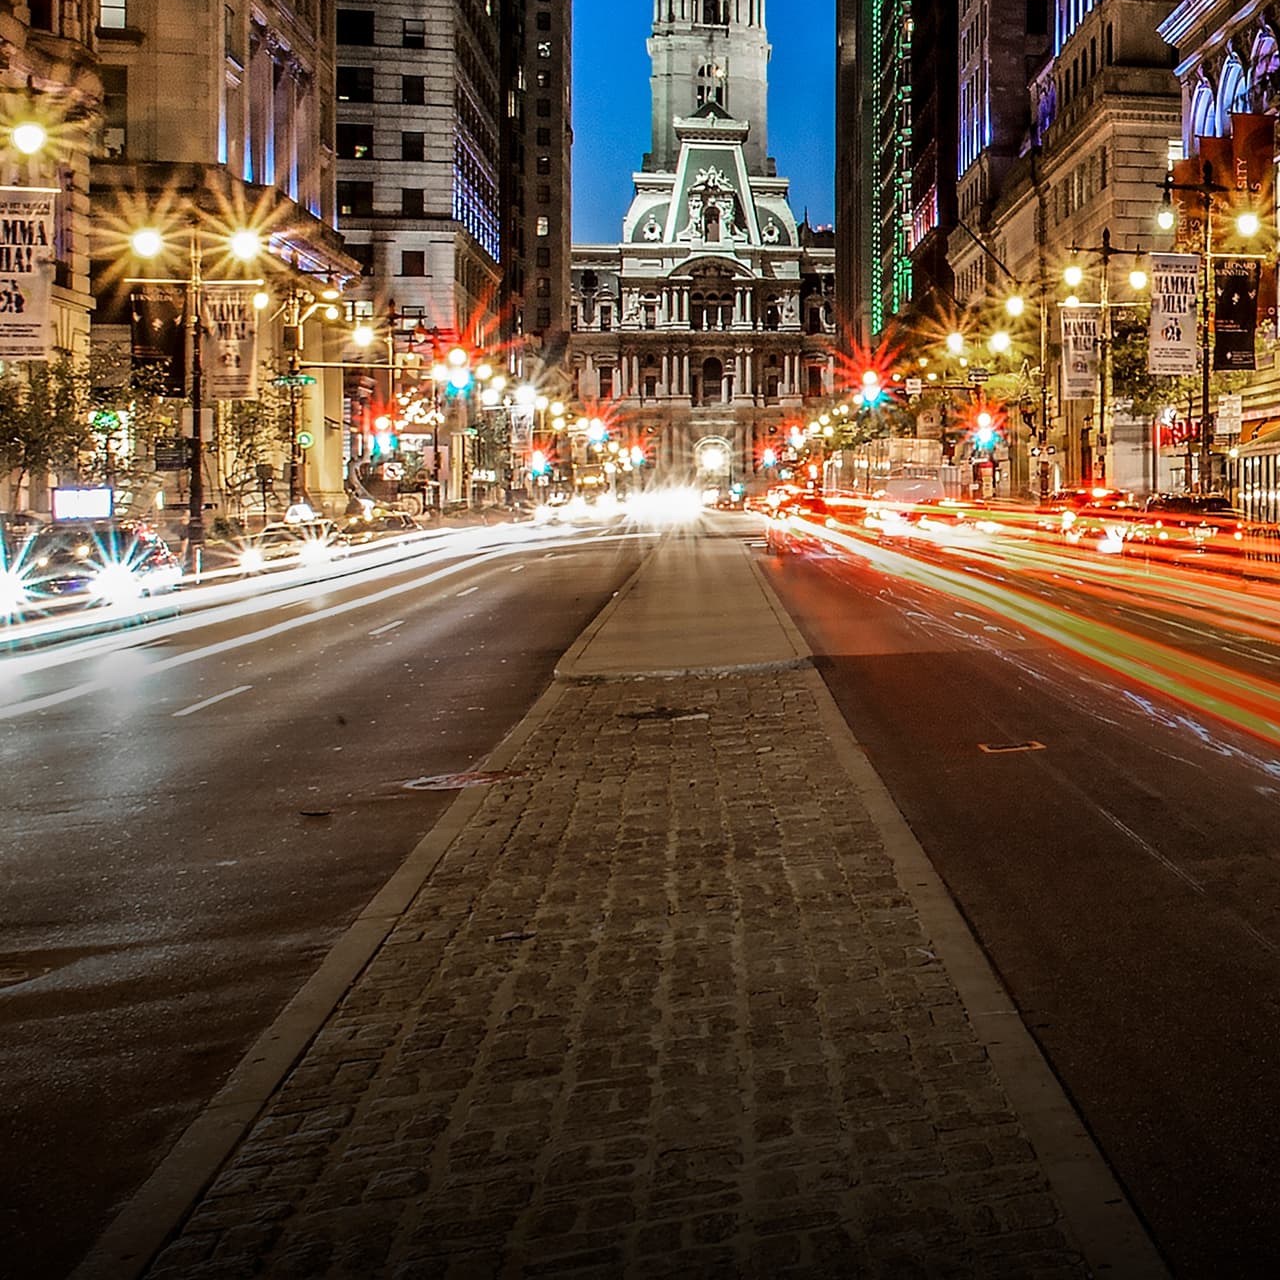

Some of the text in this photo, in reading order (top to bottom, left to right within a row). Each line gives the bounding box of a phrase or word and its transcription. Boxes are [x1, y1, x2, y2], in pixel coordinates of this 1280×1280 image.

[0, 219, 48, 246] MMA
[1153, 275, 1197, 295] MAMMA
[1160, 294, 1188, 314] MIA!
